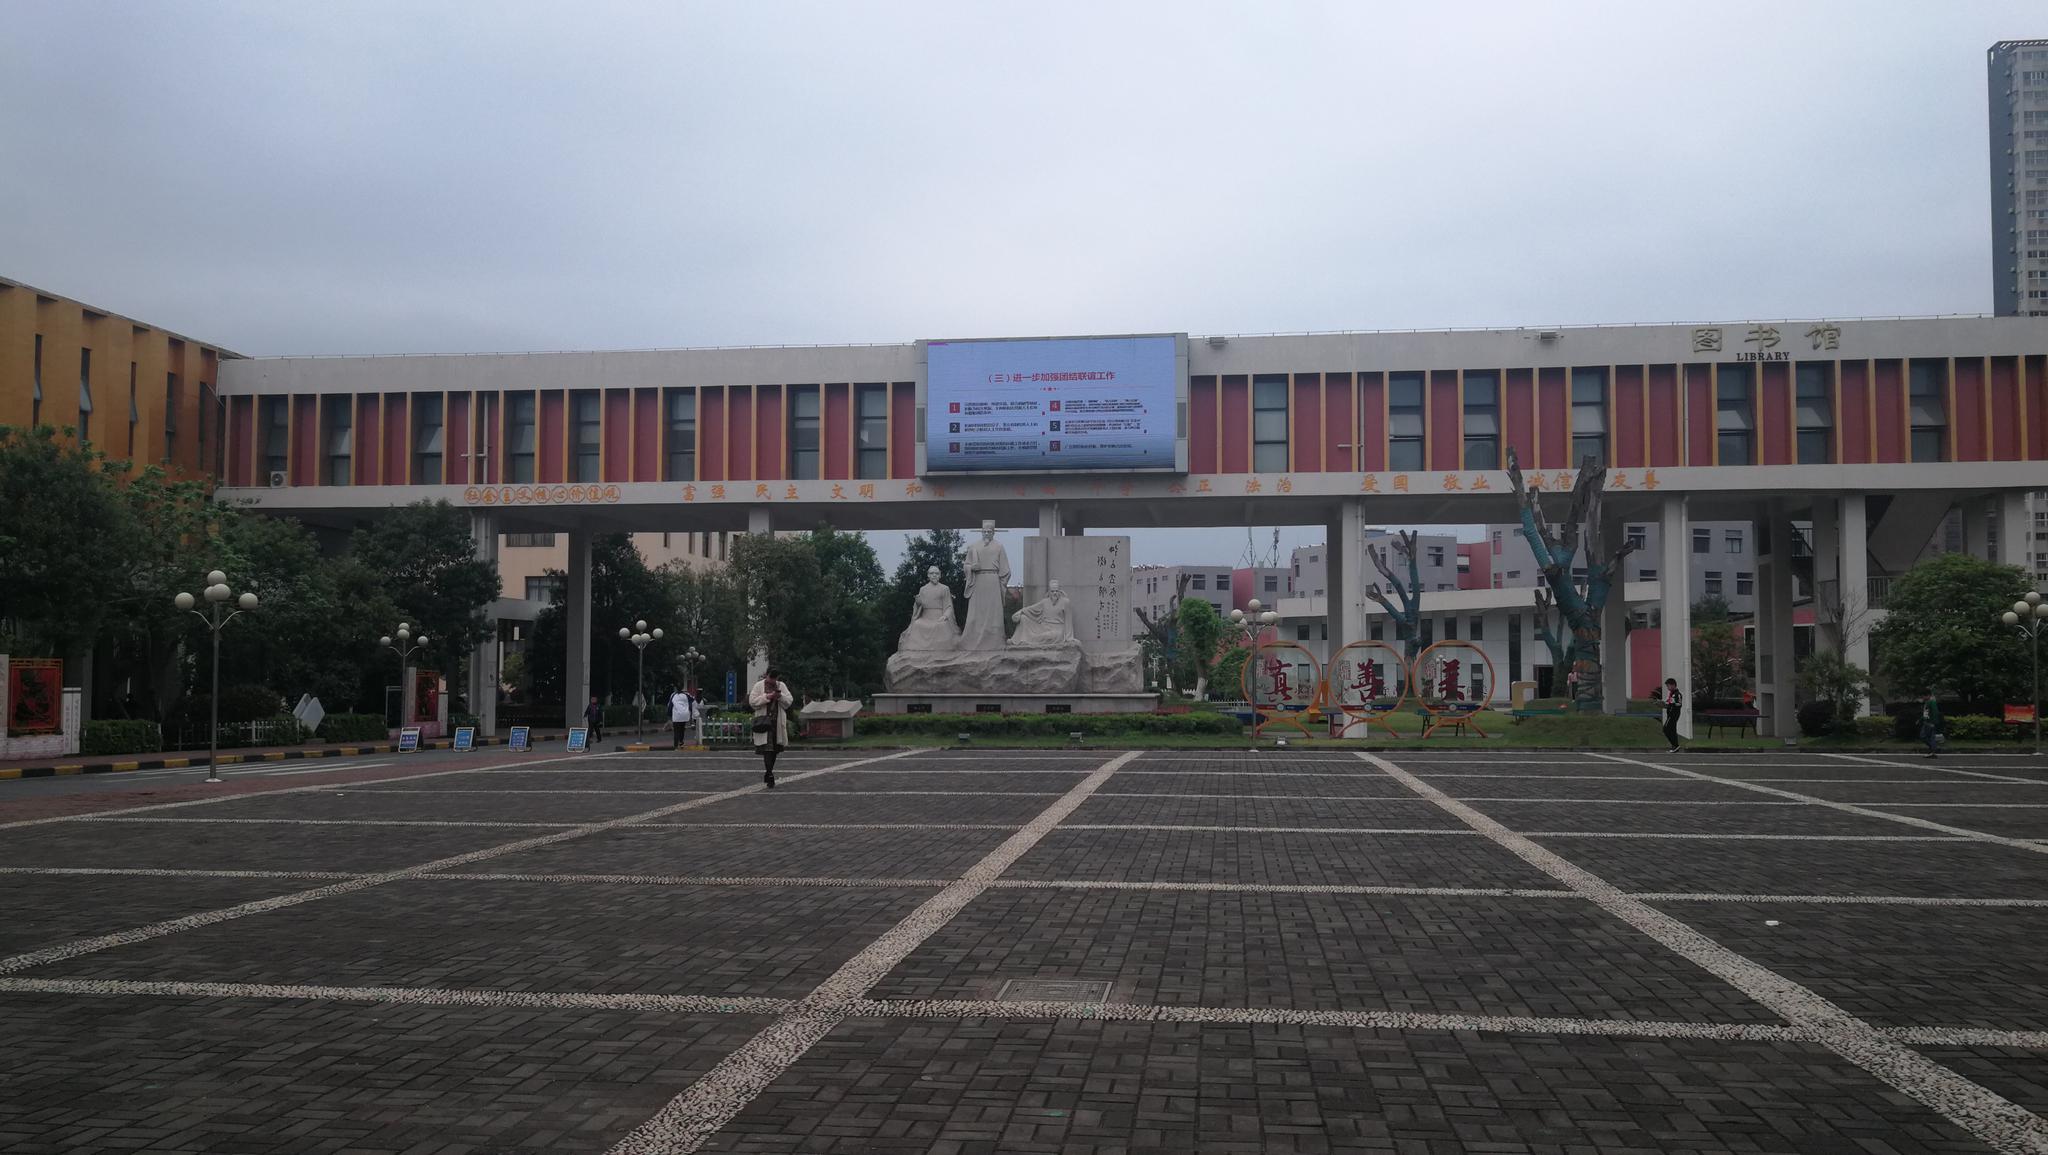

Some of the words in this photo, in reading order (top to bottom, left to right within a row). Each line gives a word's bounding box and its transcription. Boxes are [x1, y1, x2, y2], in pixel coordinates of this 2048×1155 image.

[1692, 324, 1841, 353] 图书馆
[1736, 351, 1790, 362] LIBRARY
[465, 486, 620, 504] 社会主义核心价值观
[682, 483, 726, 501] 富强
[756, 483, 799, 500] 民主
[830, 483, 874, 500] 文明
[1168, 478, 1212, 493] 公正
[1246, 477, 1292, 493] 法治
[1361, 473, 1409, 493] 爱国
[1442, 473, 1490, 491] 敬业
[1527, 471, 1573, 490] 诚信
[1610, 469, 1660, 489] 友善
[1263, 658, 1293, 701] 真
[1351, 658, 1385, 702] 善
[1438, 658, 1466, 701] 美
